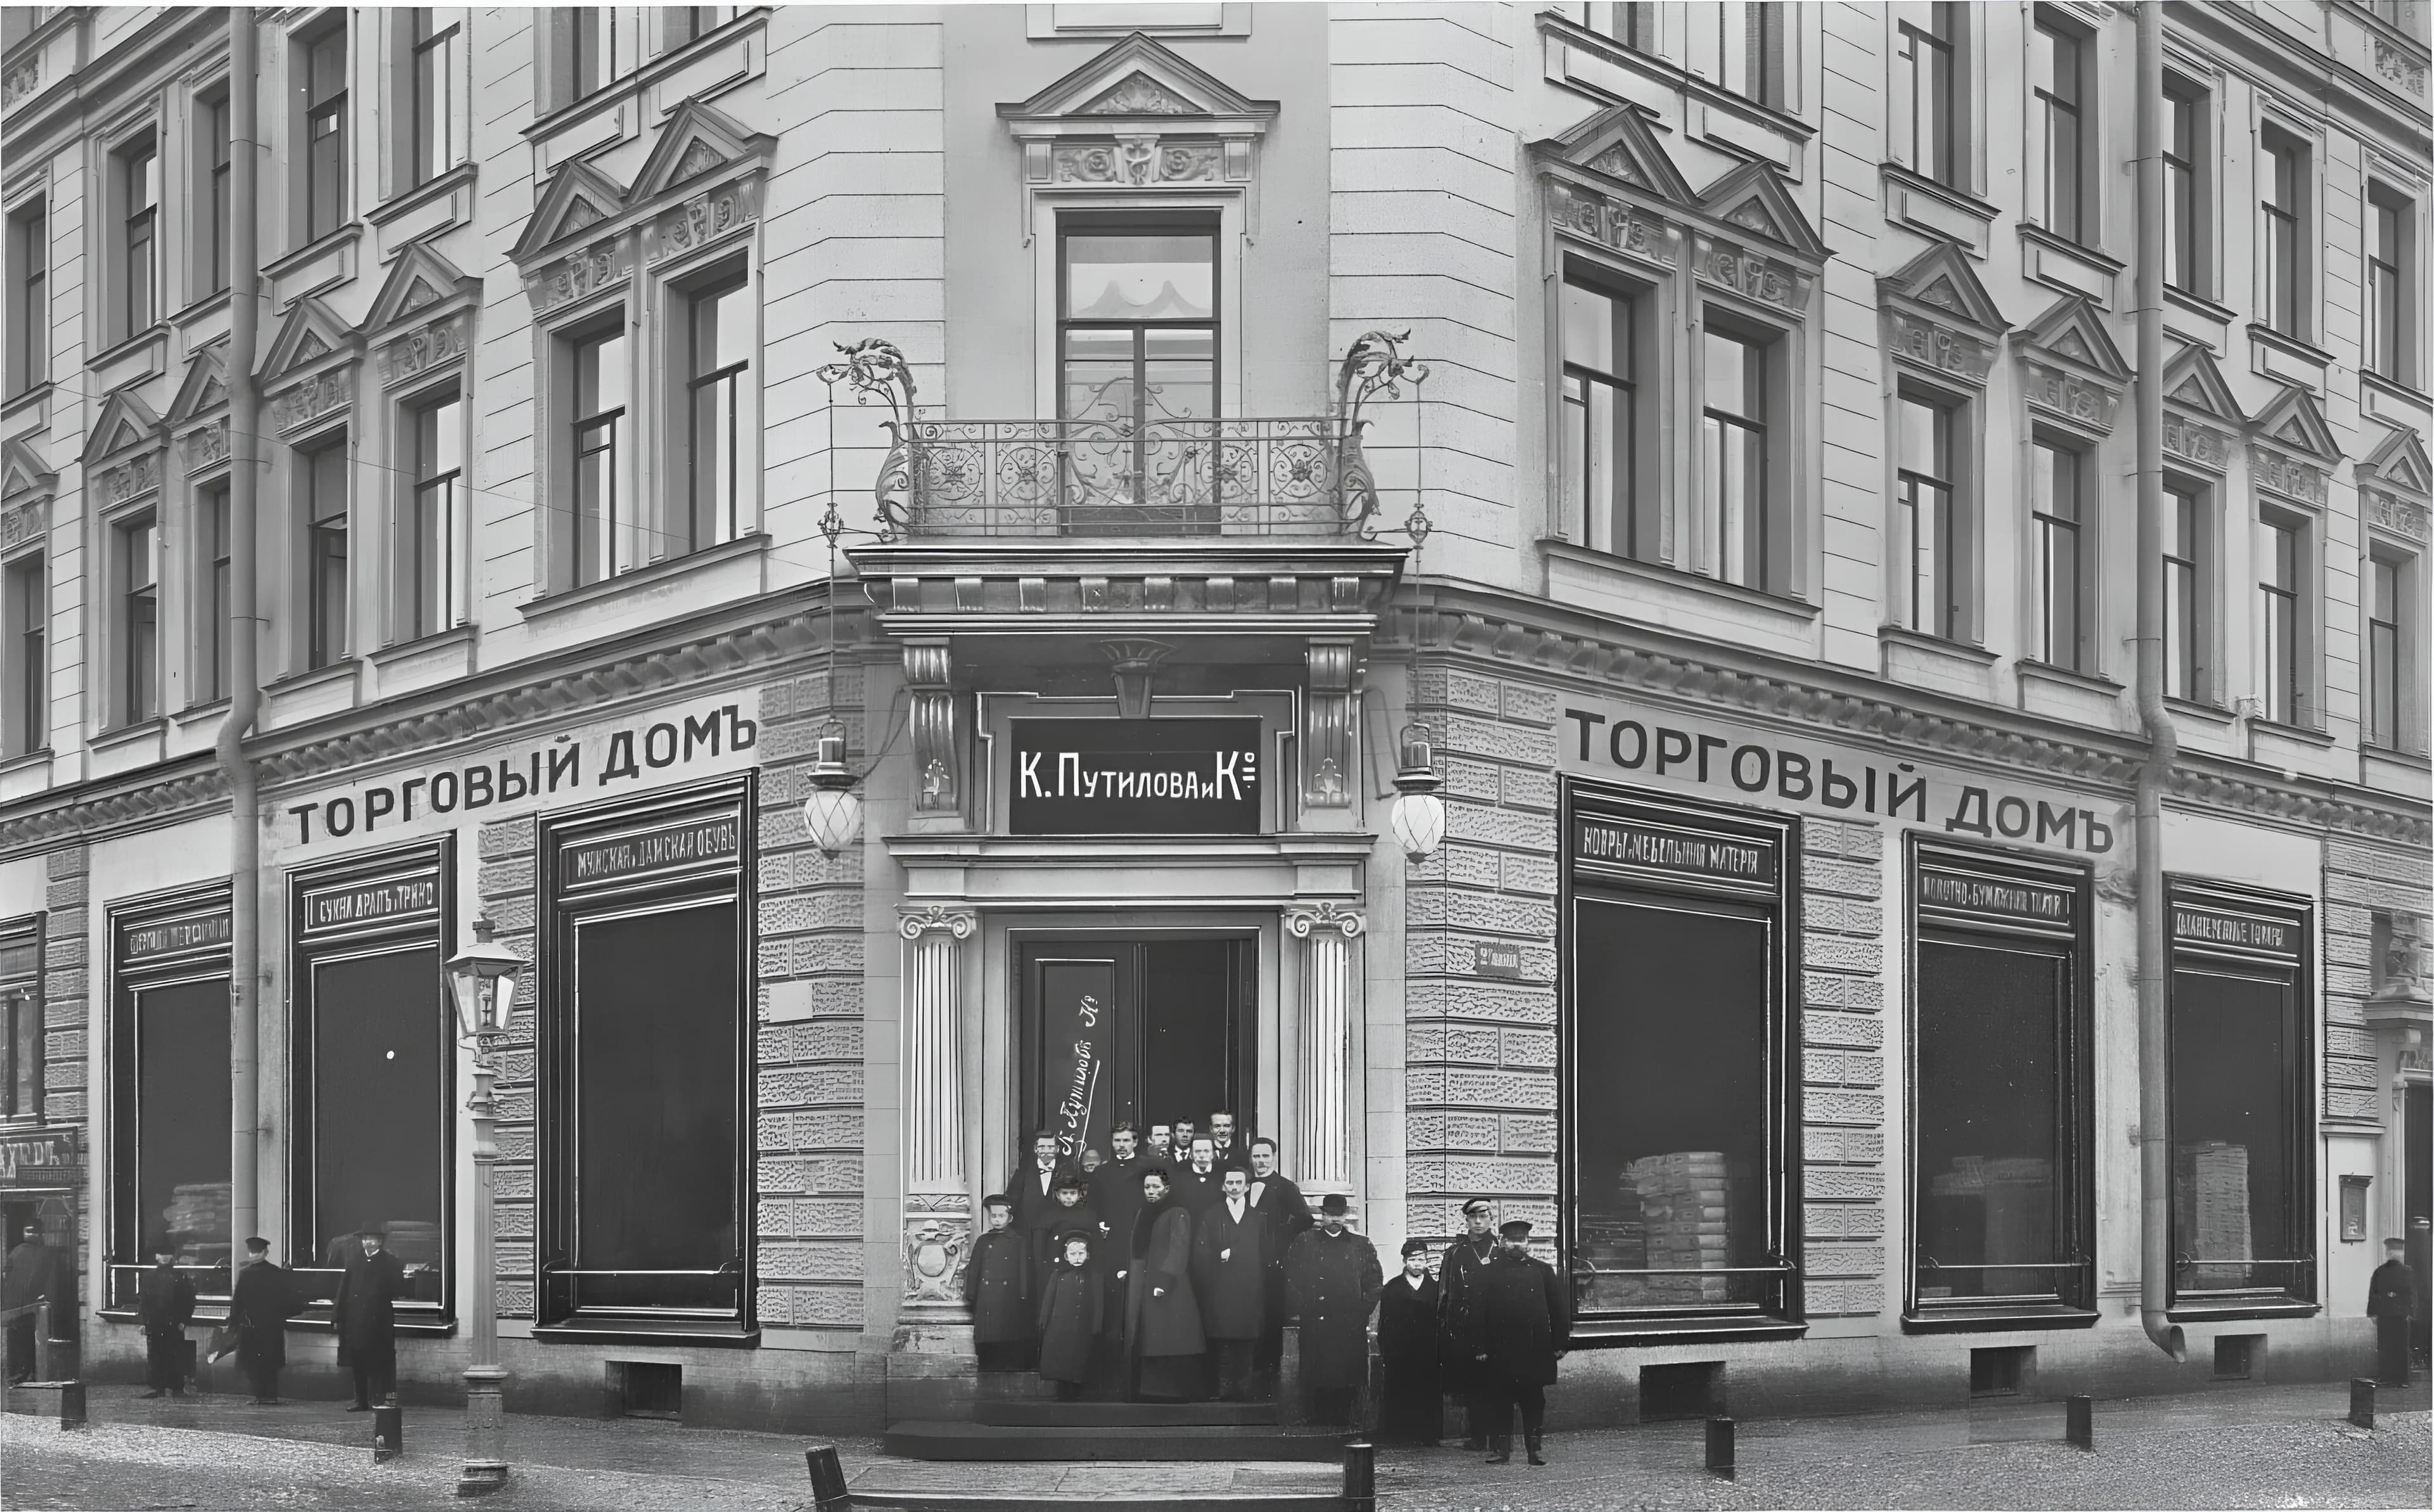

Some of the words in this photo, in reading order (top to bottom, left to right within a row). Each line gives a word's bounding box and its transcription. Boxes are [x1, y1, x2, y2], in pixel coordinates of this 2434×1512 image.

[288, 734, 580, 845] ТОРГОВЫЙ
[599, 705, 757, 786] ДОМЪ
[1021, 751, 1052, 798] К.
[1566, 708, 1926, 822] ТОРГОВЫЙ
[1945, 785, 2113, 854] ДОМЪ
[697, 823, 735, 856] ОБУВЬ
